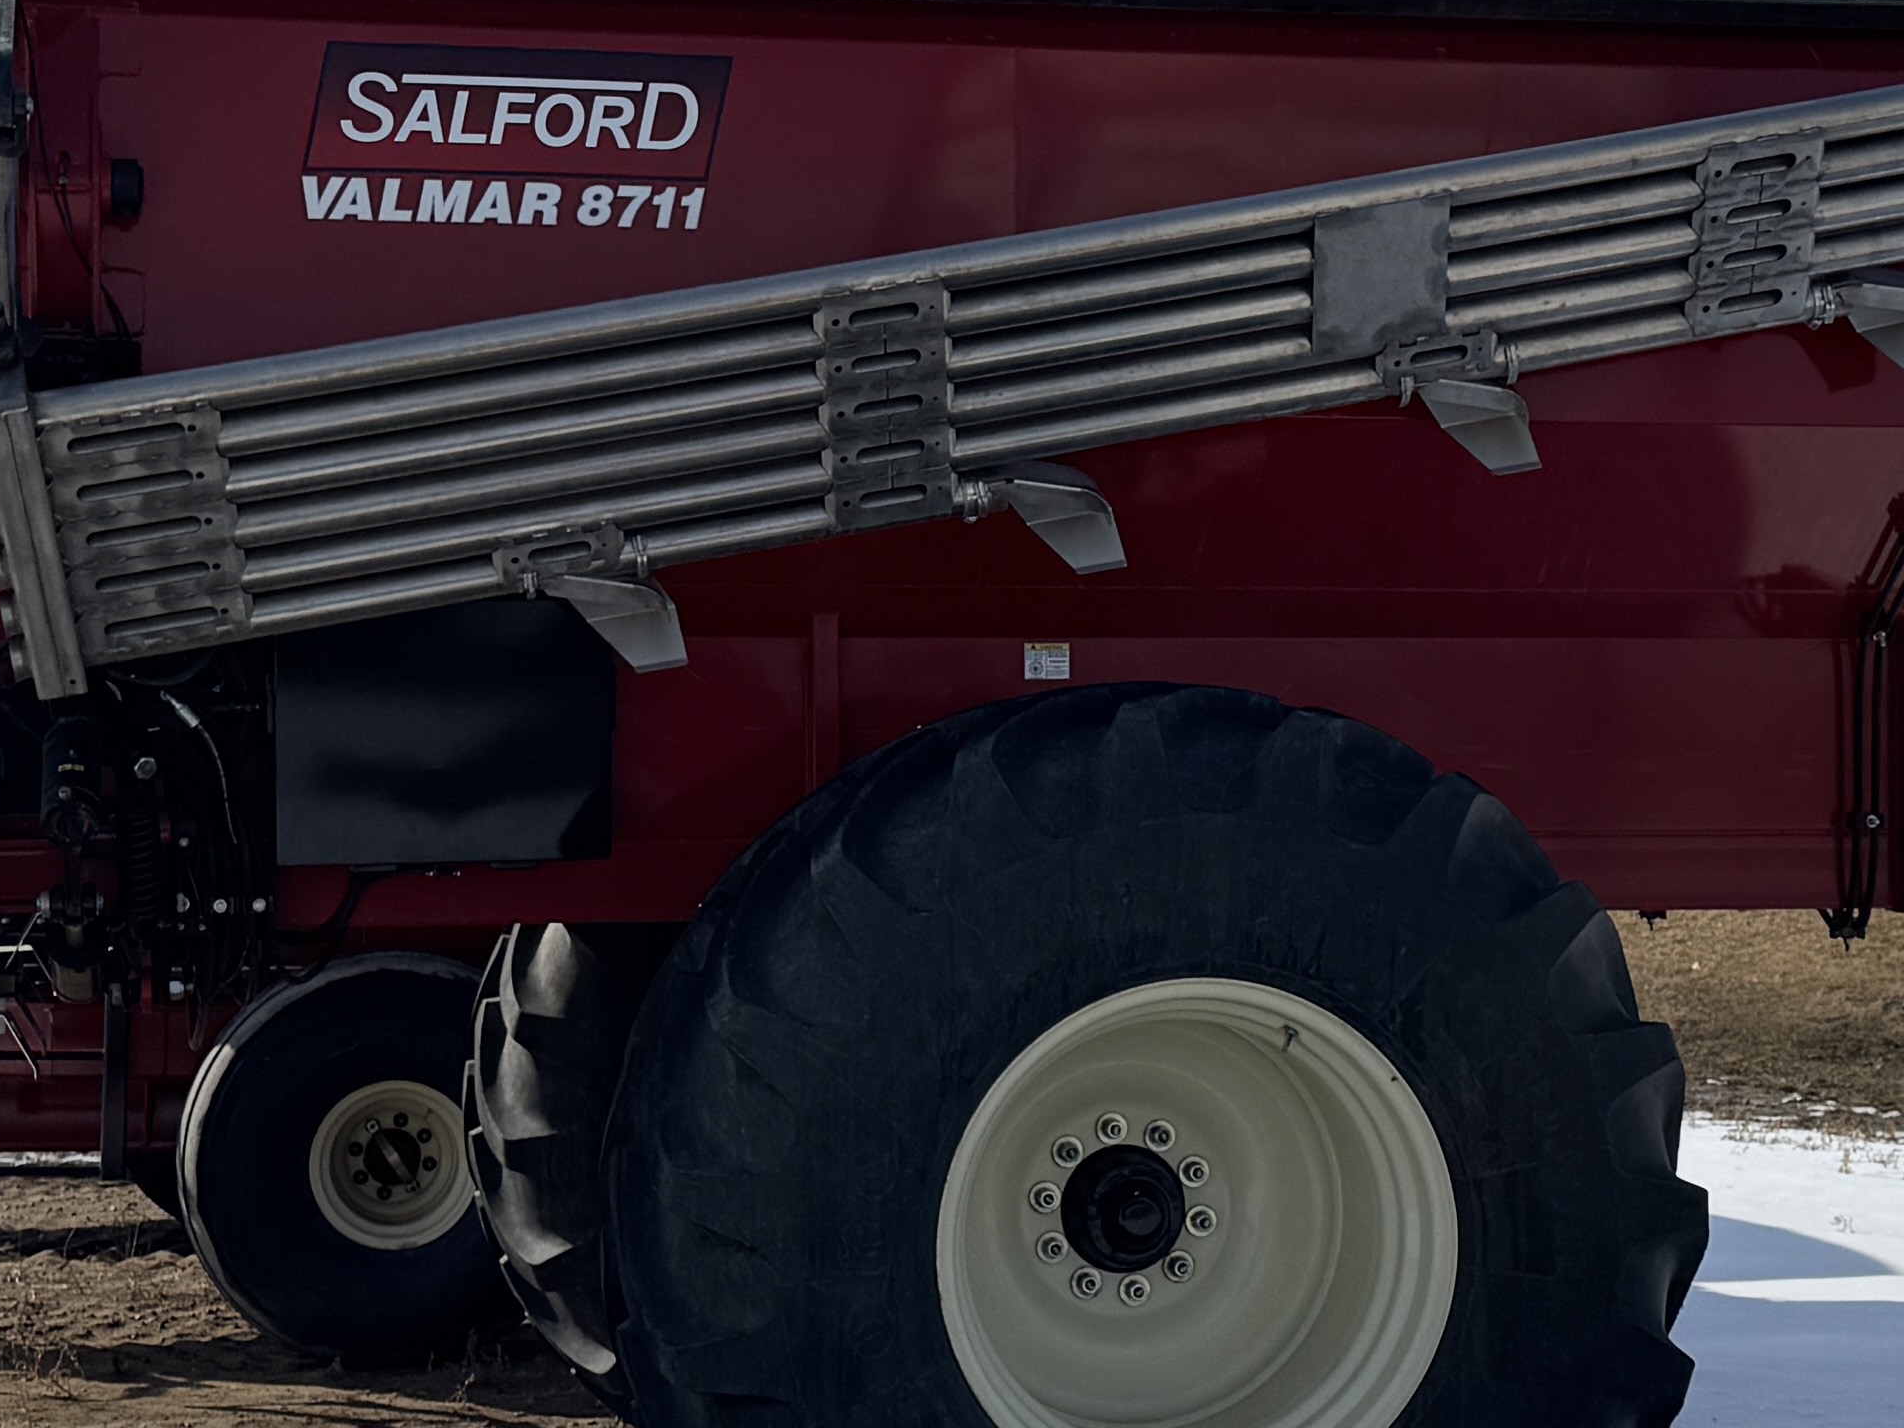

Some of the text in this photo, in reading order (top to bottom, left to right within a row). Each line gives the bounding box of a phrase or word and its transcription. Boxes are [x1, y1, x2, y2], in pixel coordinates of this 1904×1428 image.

[339, 71, 700, 151] SALFORD
[301, 174, 706, 230] VALMAR 8711
